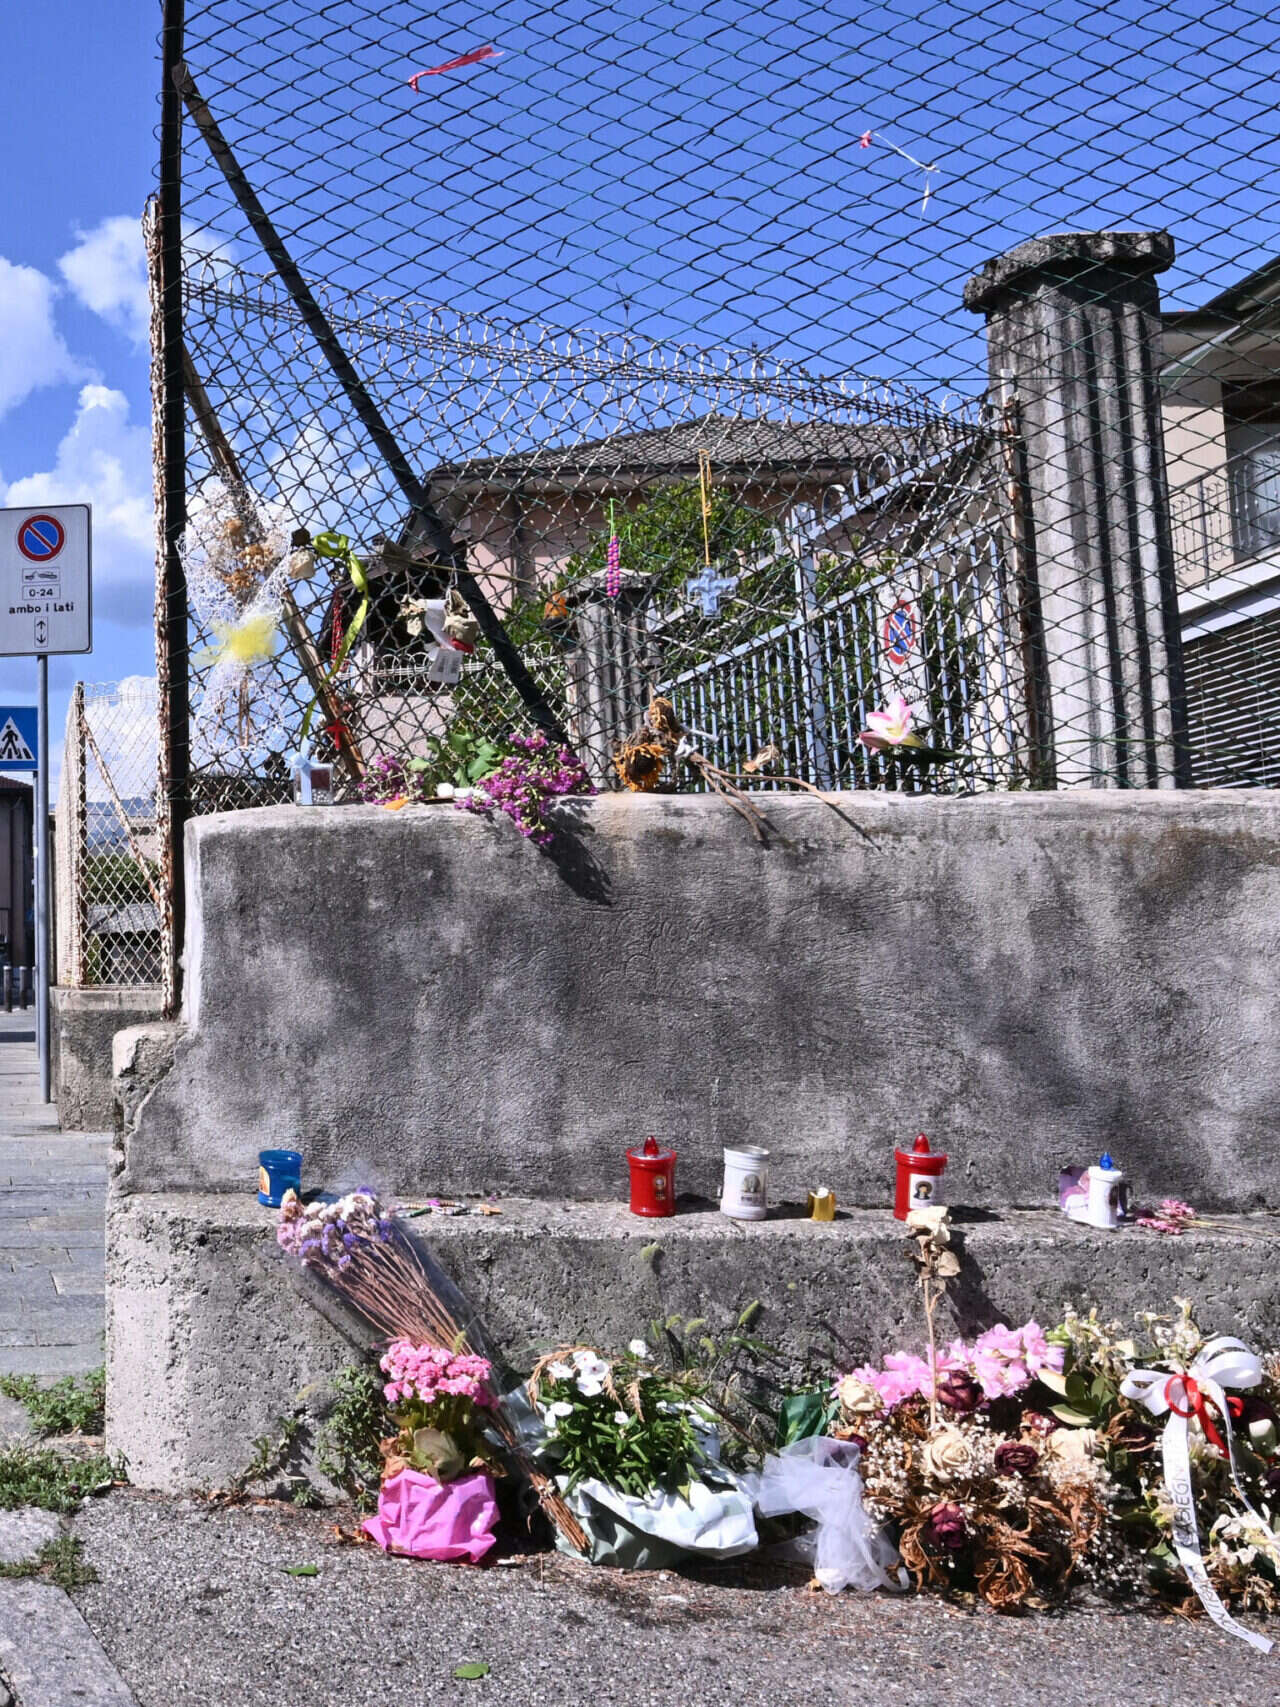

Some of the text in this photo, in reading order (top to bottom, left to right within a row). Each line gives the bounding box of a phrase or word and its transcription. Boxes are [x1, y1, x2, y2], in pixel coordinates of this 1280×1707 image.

[29, 588, 53, 597] 0-24
[9, 604, 41, 614] ambo
[54, 602, 74, 612] lati
